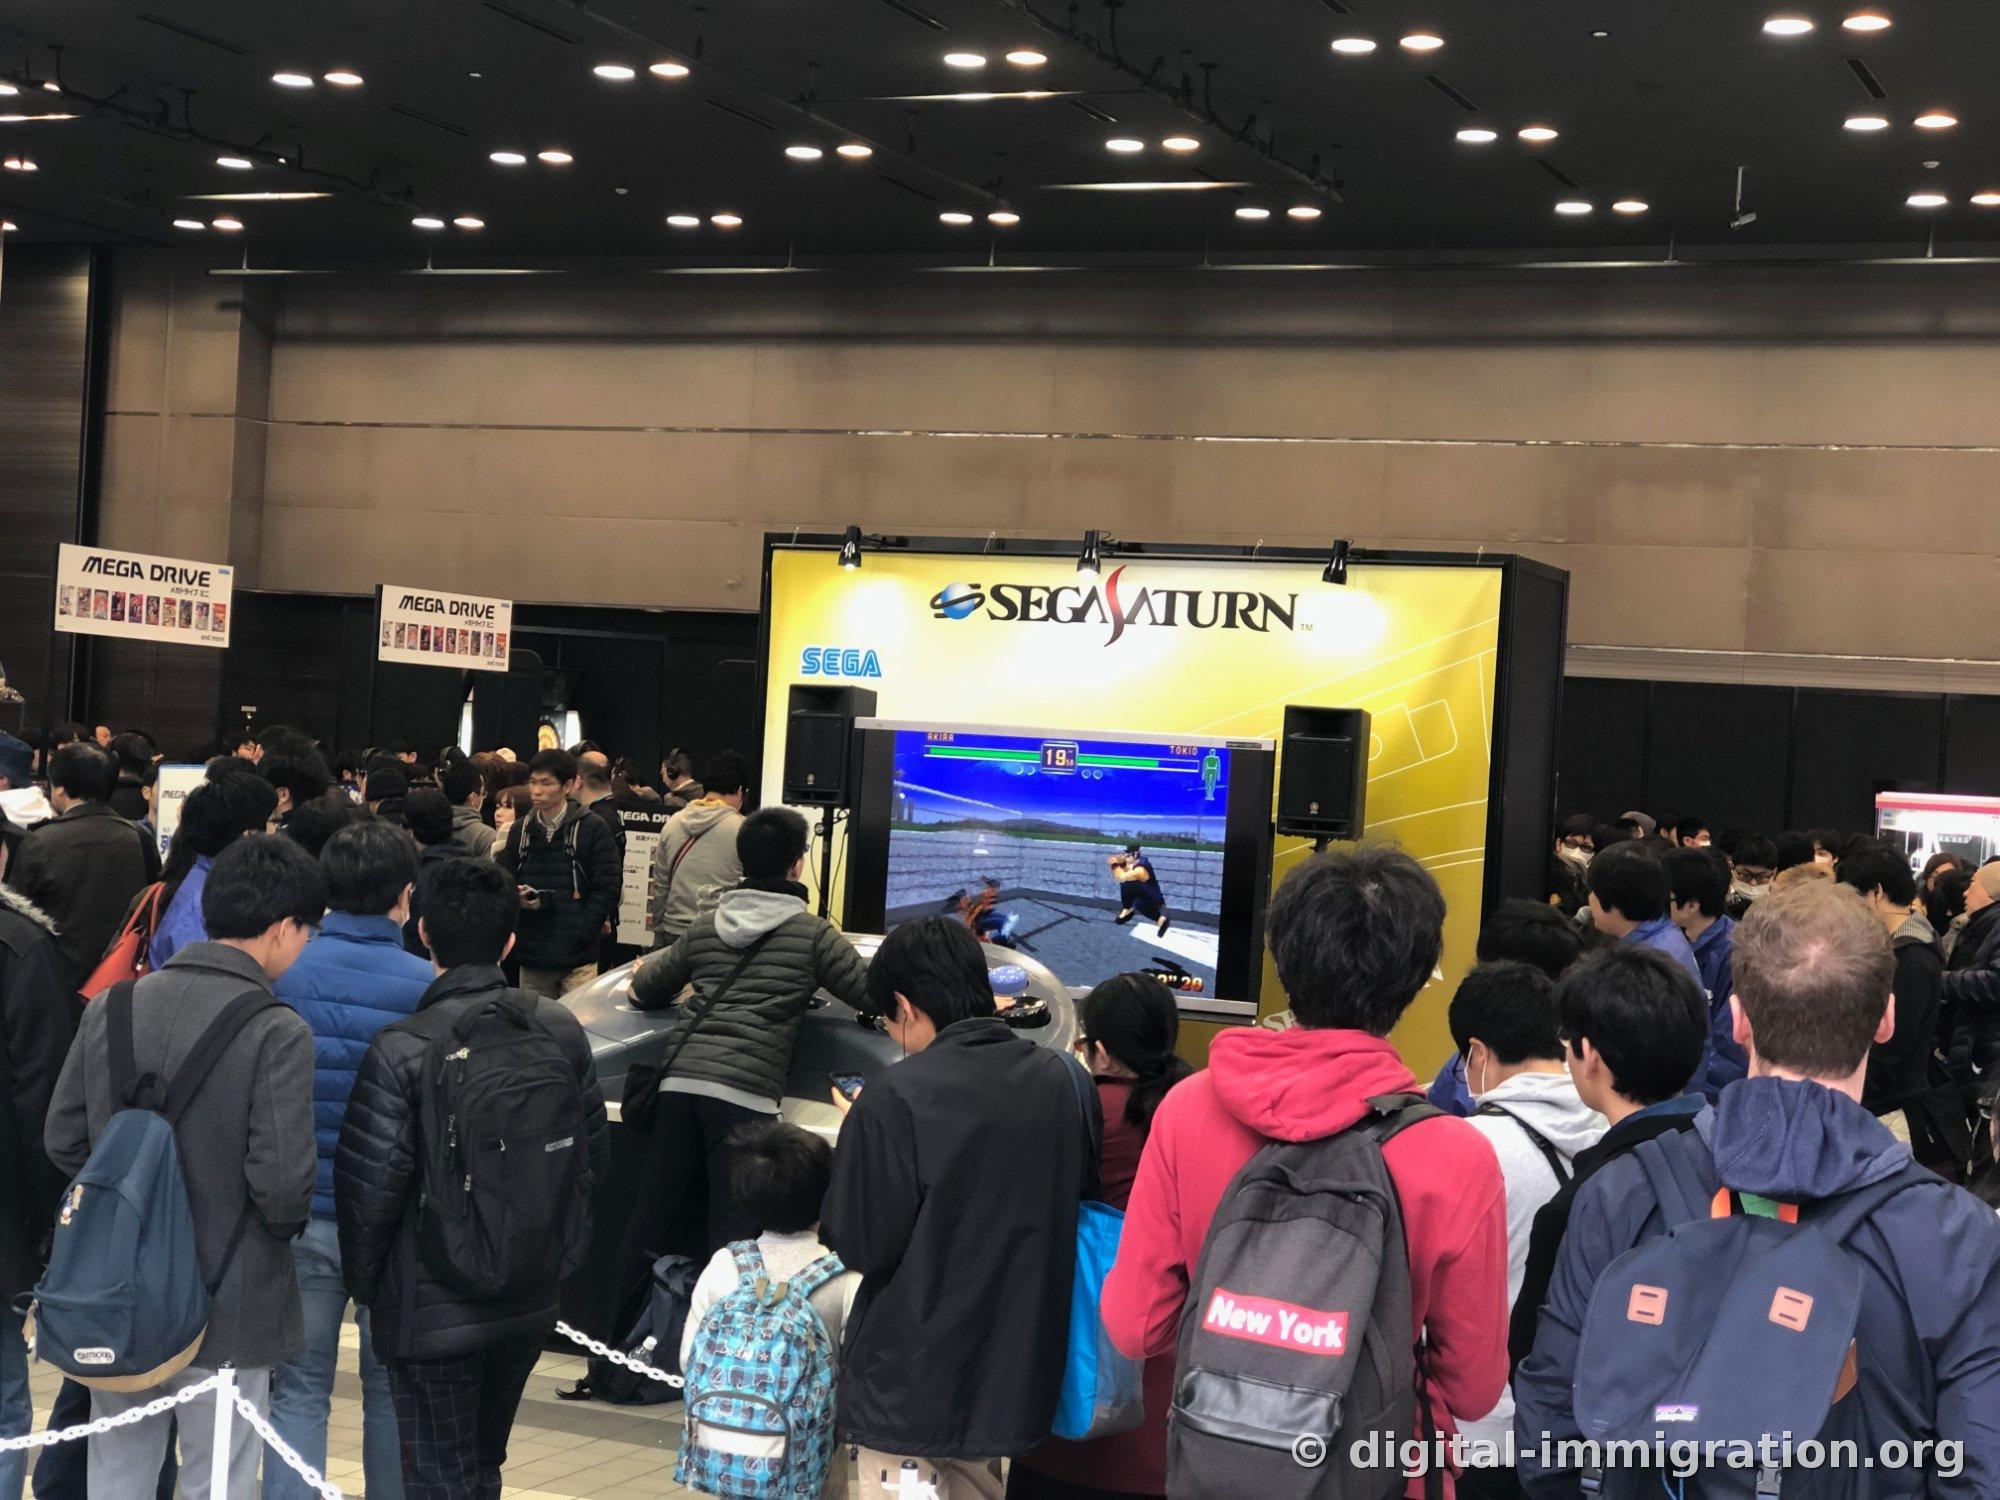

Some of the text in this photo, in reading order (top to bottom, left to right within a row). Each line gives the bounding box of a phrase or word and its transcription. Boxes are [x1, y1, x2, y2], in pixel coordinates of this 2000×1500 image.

[81, 555, 211, 588] MEGA DRIVE
[398, 594, 495, 620] MEGA DRIVE
[801, 647, 882, 678] SEGA
[927, 731, 955, 742] AKIRA
[1207, 1295, 1343, 1348] New York
